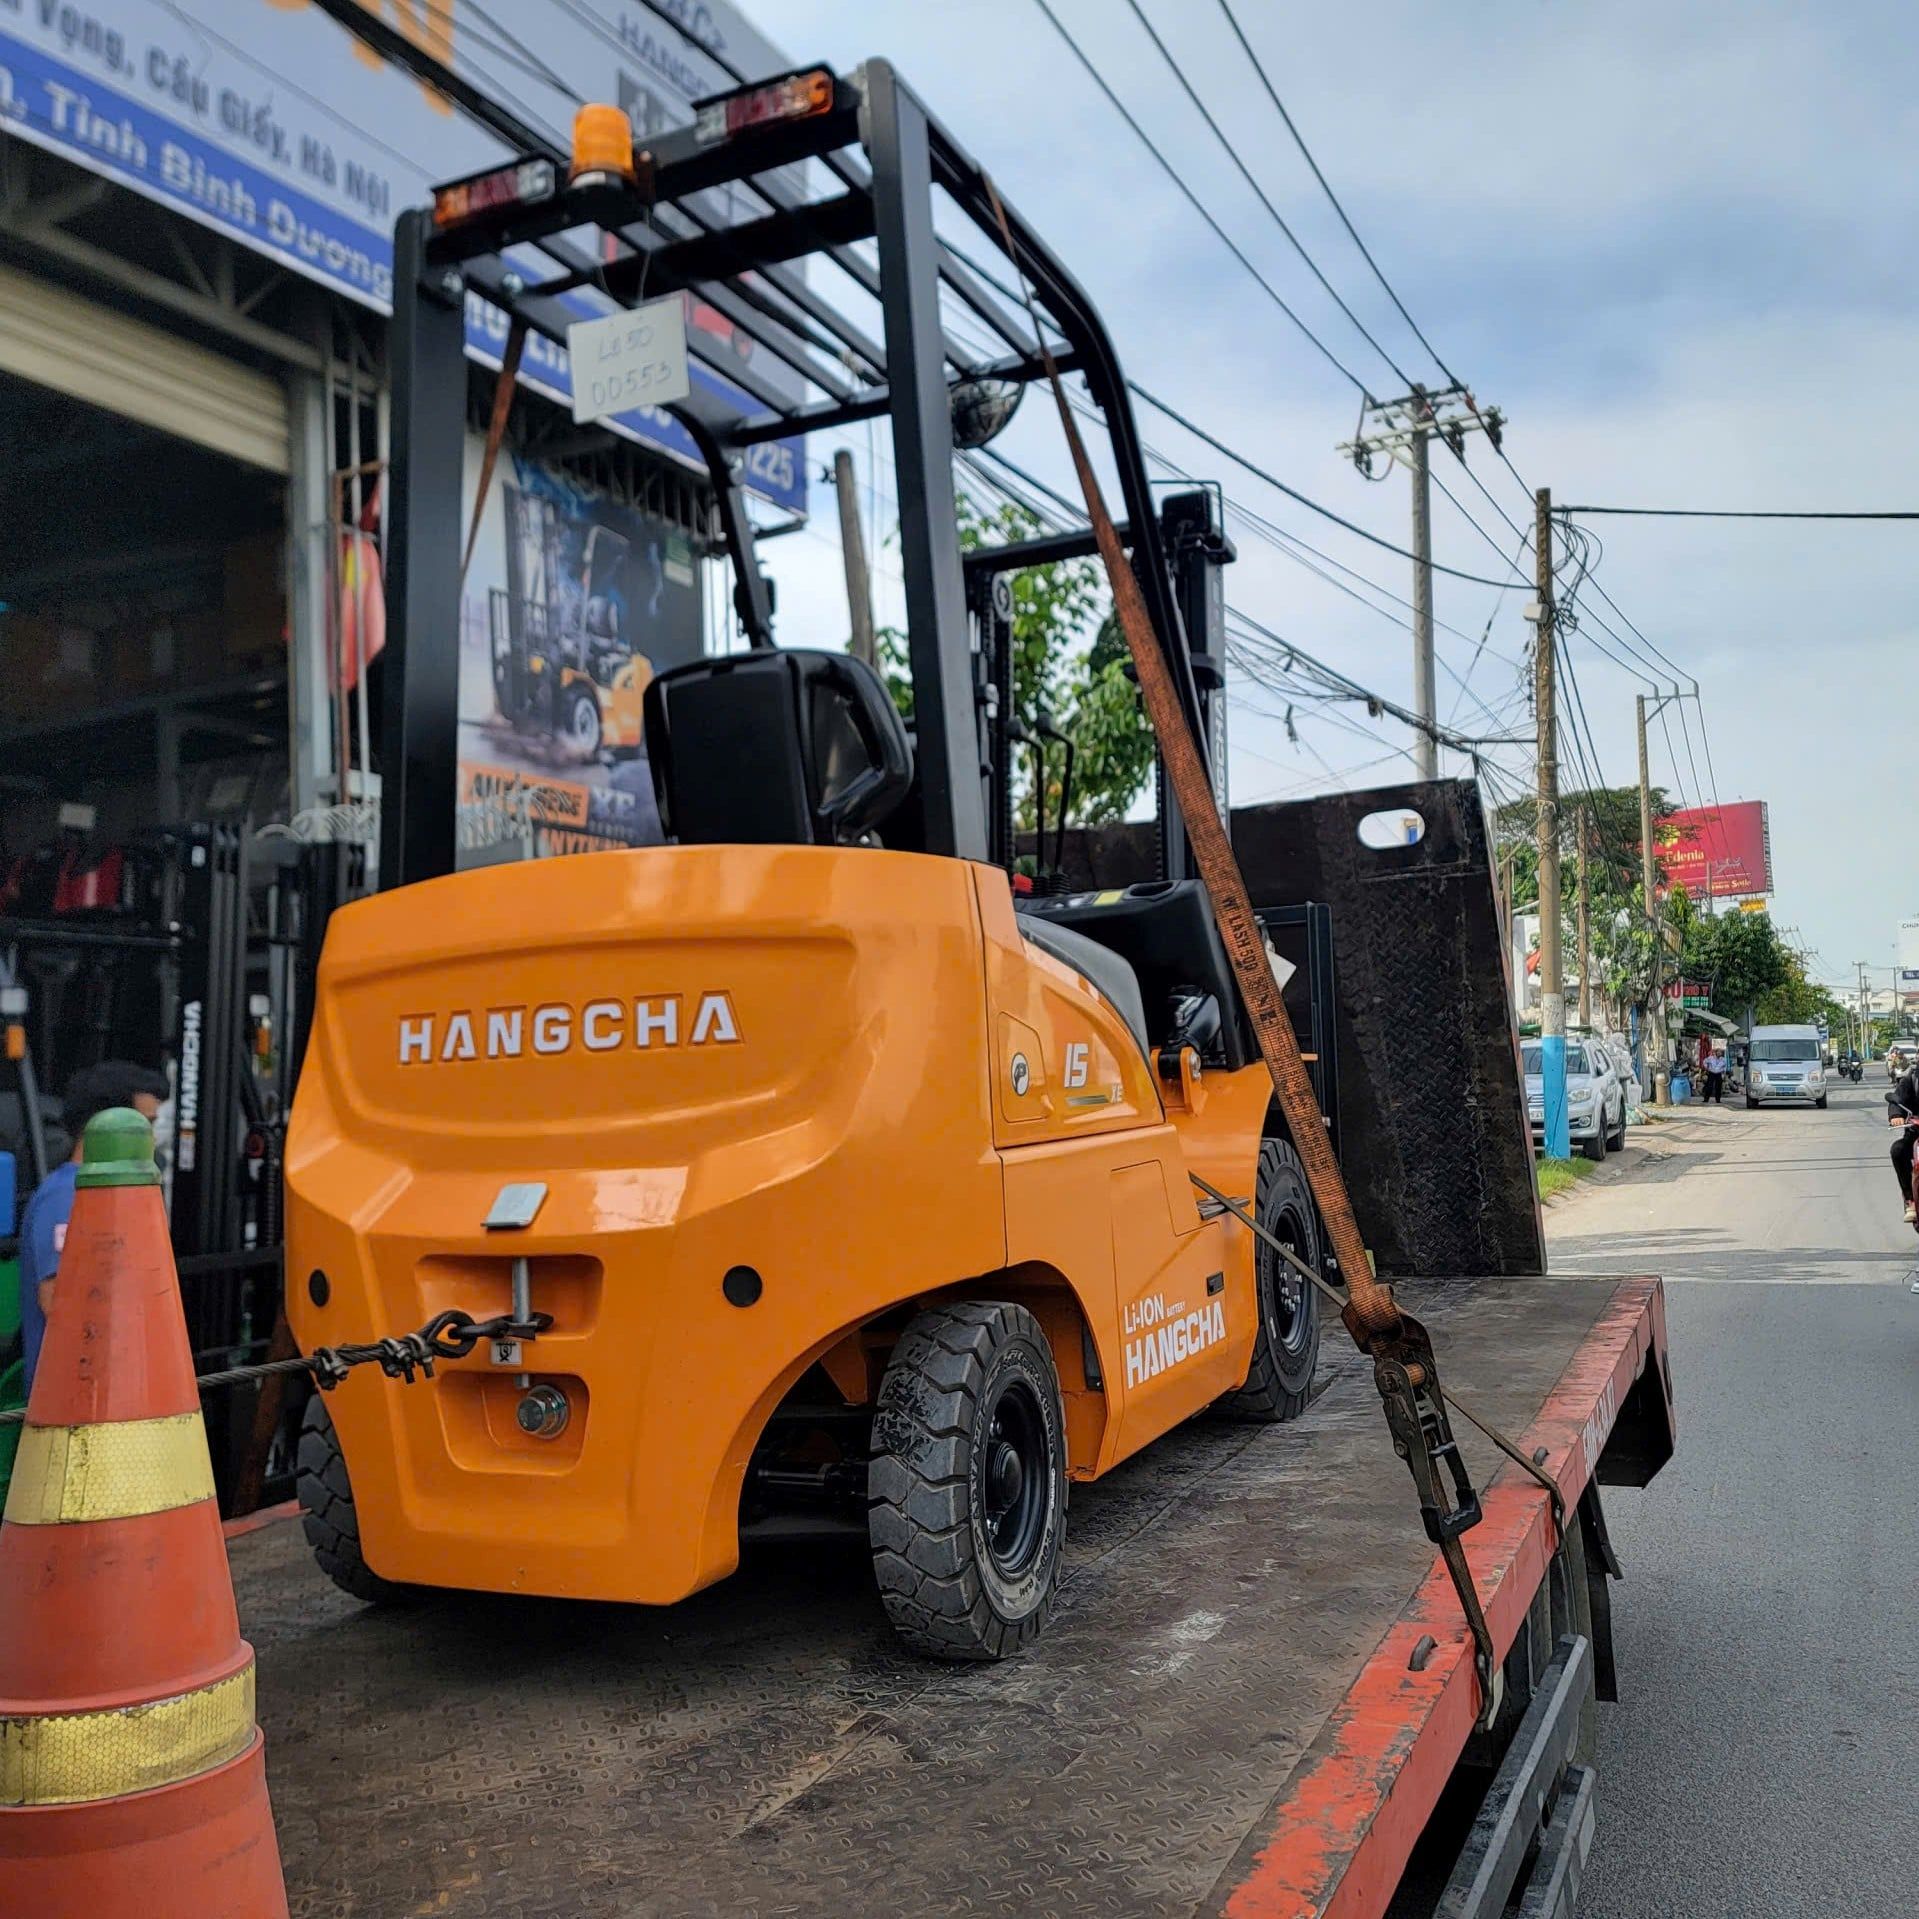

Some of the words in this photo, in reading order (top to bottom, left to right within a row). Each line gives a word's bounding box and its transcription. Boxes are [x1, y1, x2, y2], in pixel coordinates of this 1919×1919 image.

[160, 139, 258, 228] Bình
[267, 196, 392, 298] Dương
[1229, 913, 1252, 949] LASH
[399, 993, 741, 1064] HANGCHA
[1064, 1043, 1089, 1088] 15
[1125, 1301, 1226, 1390] HANGCHA
